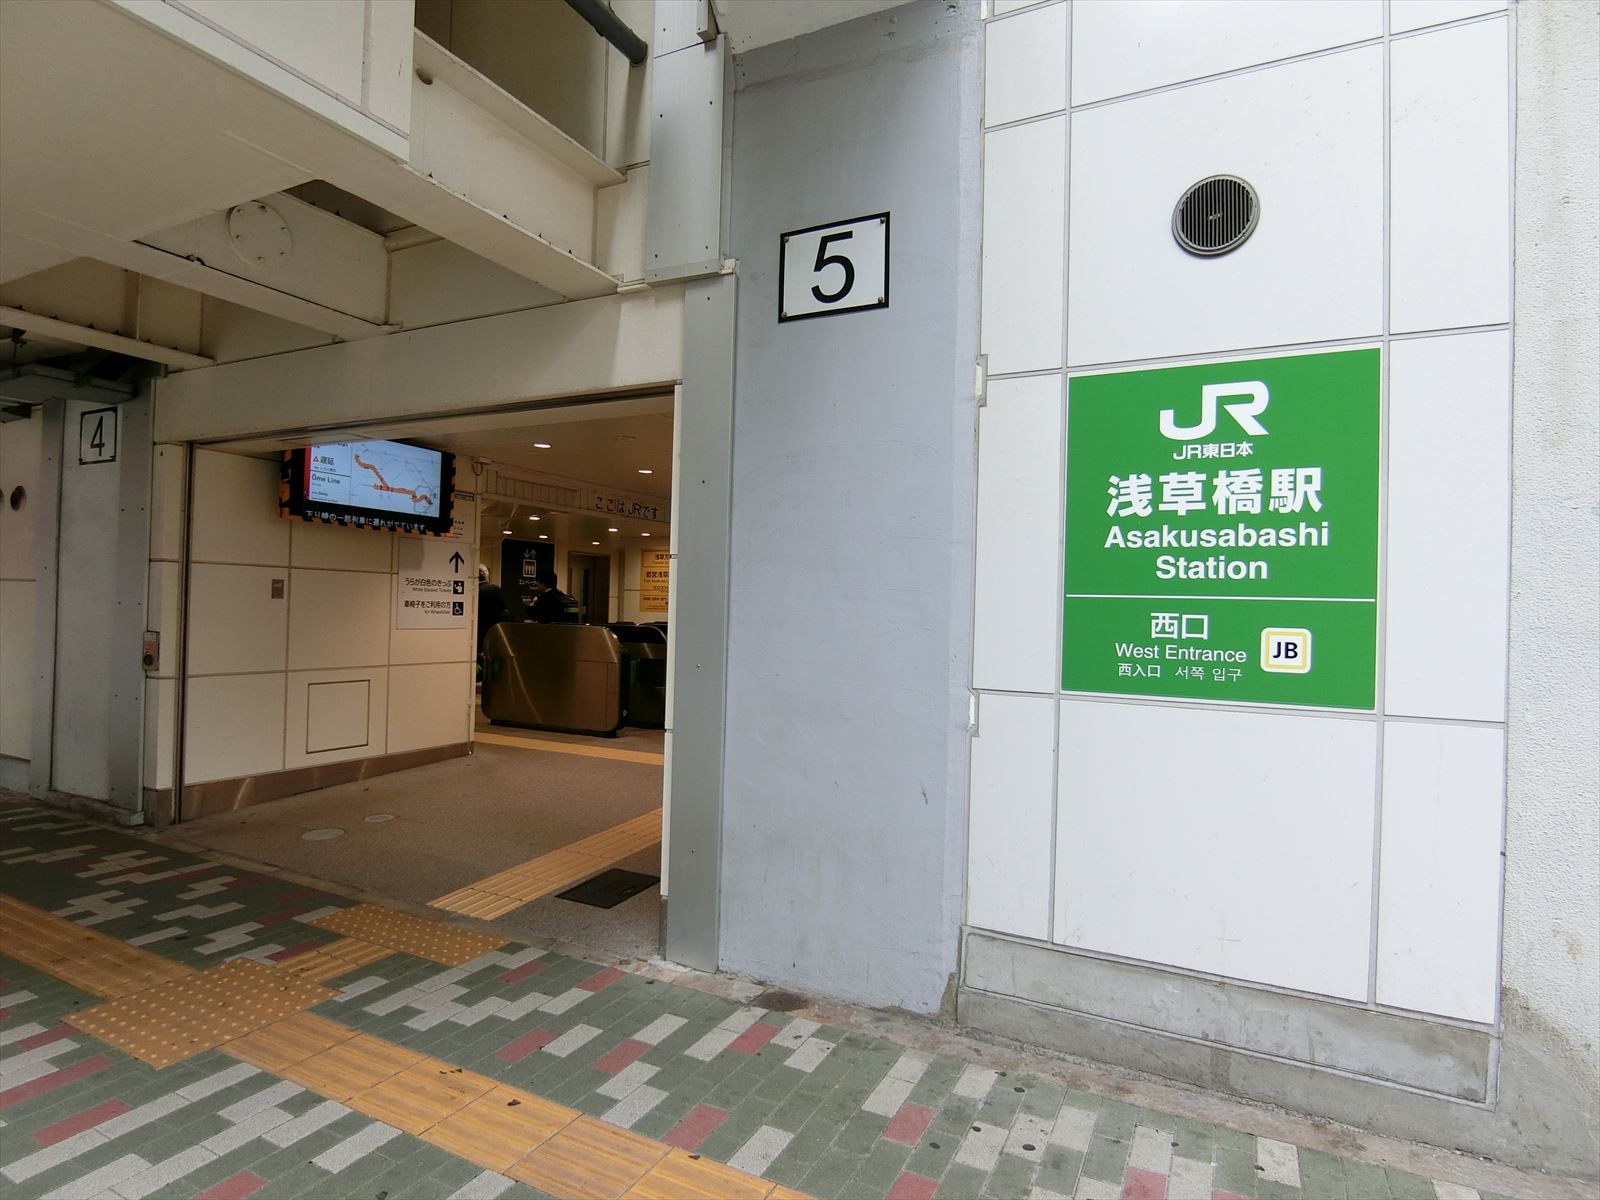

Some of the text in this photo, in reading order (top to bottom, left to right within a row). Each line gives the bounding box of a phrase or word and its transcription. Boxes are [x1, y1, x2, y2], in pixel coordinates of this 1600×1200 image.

[811, 230, 855, 304] 5
[1159, 380, 1270, 441] JR
[90, 415, 105, 457] 4
[1172, 440, 1254, 460] JR東日本
[1106, 467, 1323, 518] 浅草橋駅
[1104, 521, 1330, 550] Asakusabashi
[1155, 555, 1269, 581] Station
[1150, 612, 1209, 640] 西口
[1115, 642, 1247, 663] West Entrance
[1272, 641, 1299, 660] JB
[1118, 663, 1161, 678] 西入口
[1175, 665, 1243, 682] 서쪽 입구
